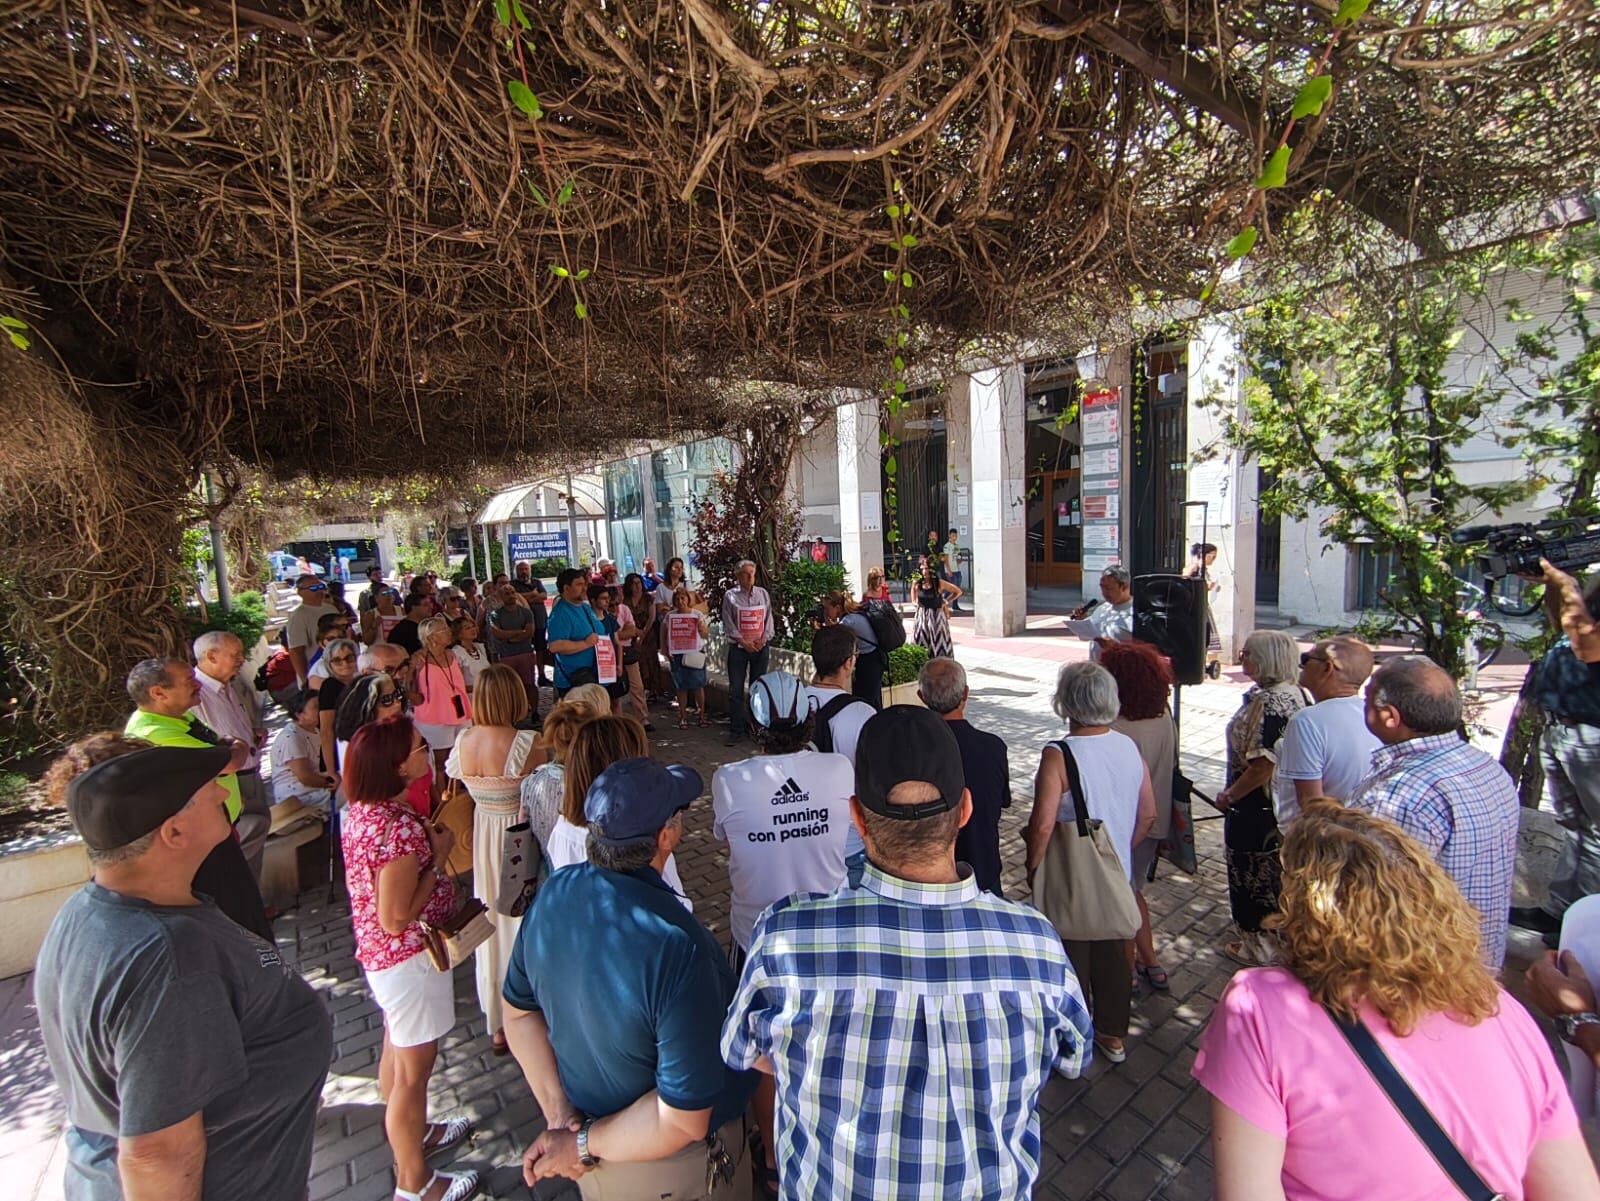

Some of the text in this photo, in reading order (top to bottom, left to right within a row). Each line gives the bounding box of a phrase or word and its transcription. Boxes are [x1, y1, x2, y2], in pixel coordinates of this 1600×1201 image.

[538, 549, 567, 557] Peatones
[771, 792, 809, 805] adidas
[773, 808, 828, 825] running
[748, 822, 829, 842] con pasión
